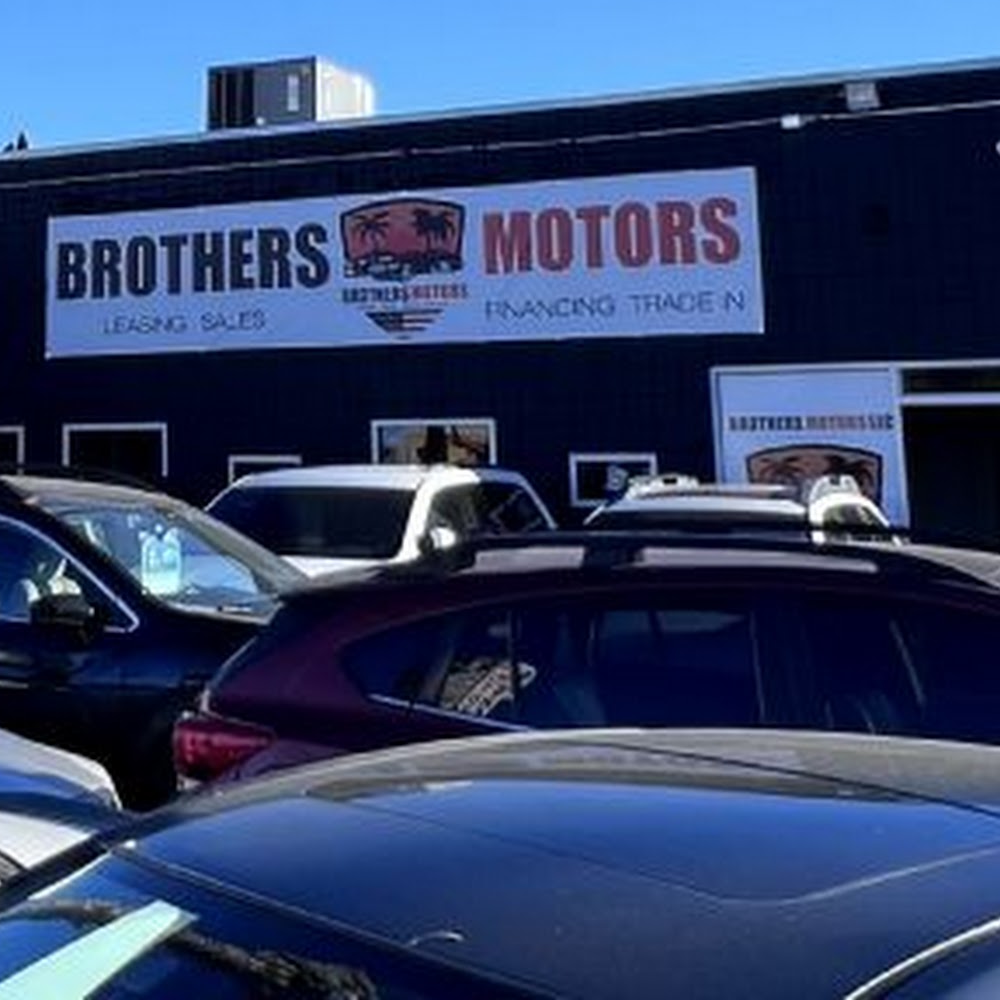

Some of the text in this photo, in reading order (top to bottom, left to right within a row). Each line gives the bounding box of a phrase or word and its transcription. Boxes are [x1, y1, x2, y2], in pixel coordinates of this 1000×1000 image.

[56, 198, 741, 300] BROTHERS MOTORS
[629, 292, 713, 316] TRADE
[104, 310, 266, 336] LEASING SALES
